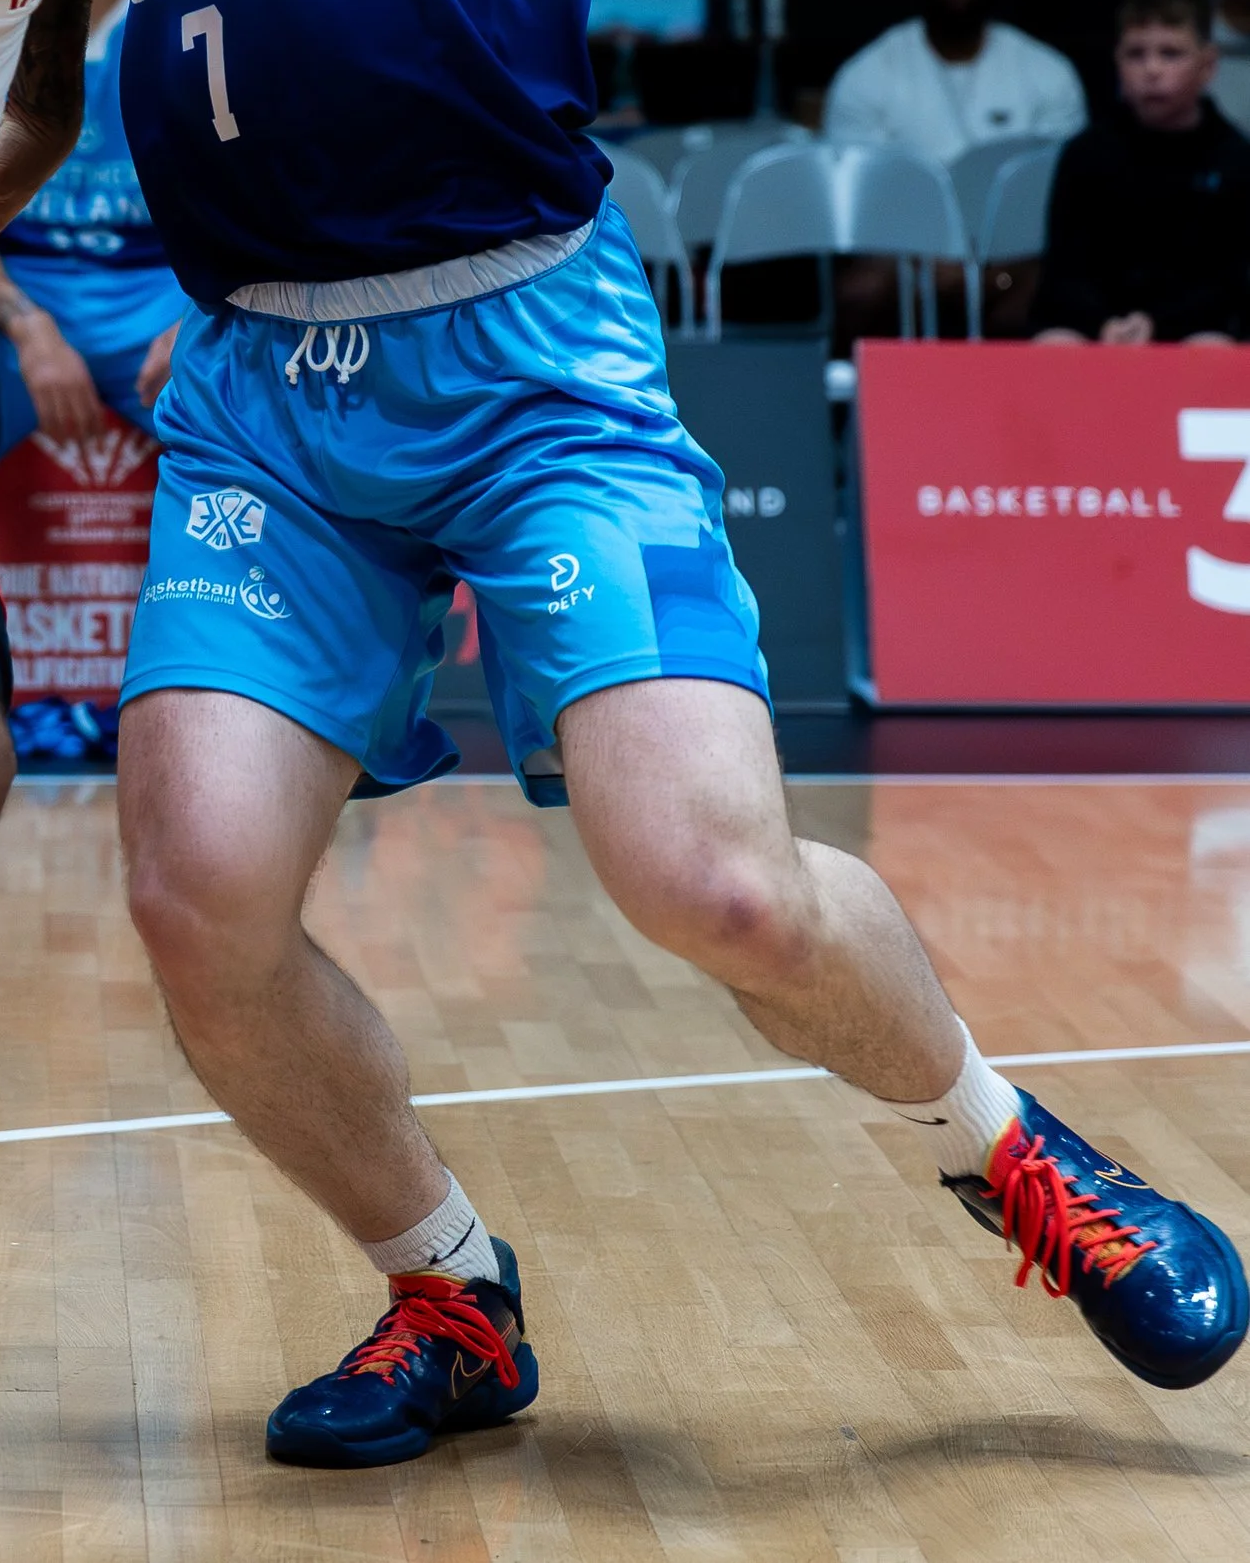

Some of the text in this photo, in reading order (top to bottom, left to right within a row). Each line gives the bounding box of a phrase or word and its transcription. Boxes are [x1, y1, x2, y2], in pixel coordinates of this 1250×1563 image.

[181, 4, 241, 143] 7
[916, 485, 1182, 518] BASKETBALL
[144, 576, 237, 604] Basketball
[548, 584, 595, 615] DEFY
